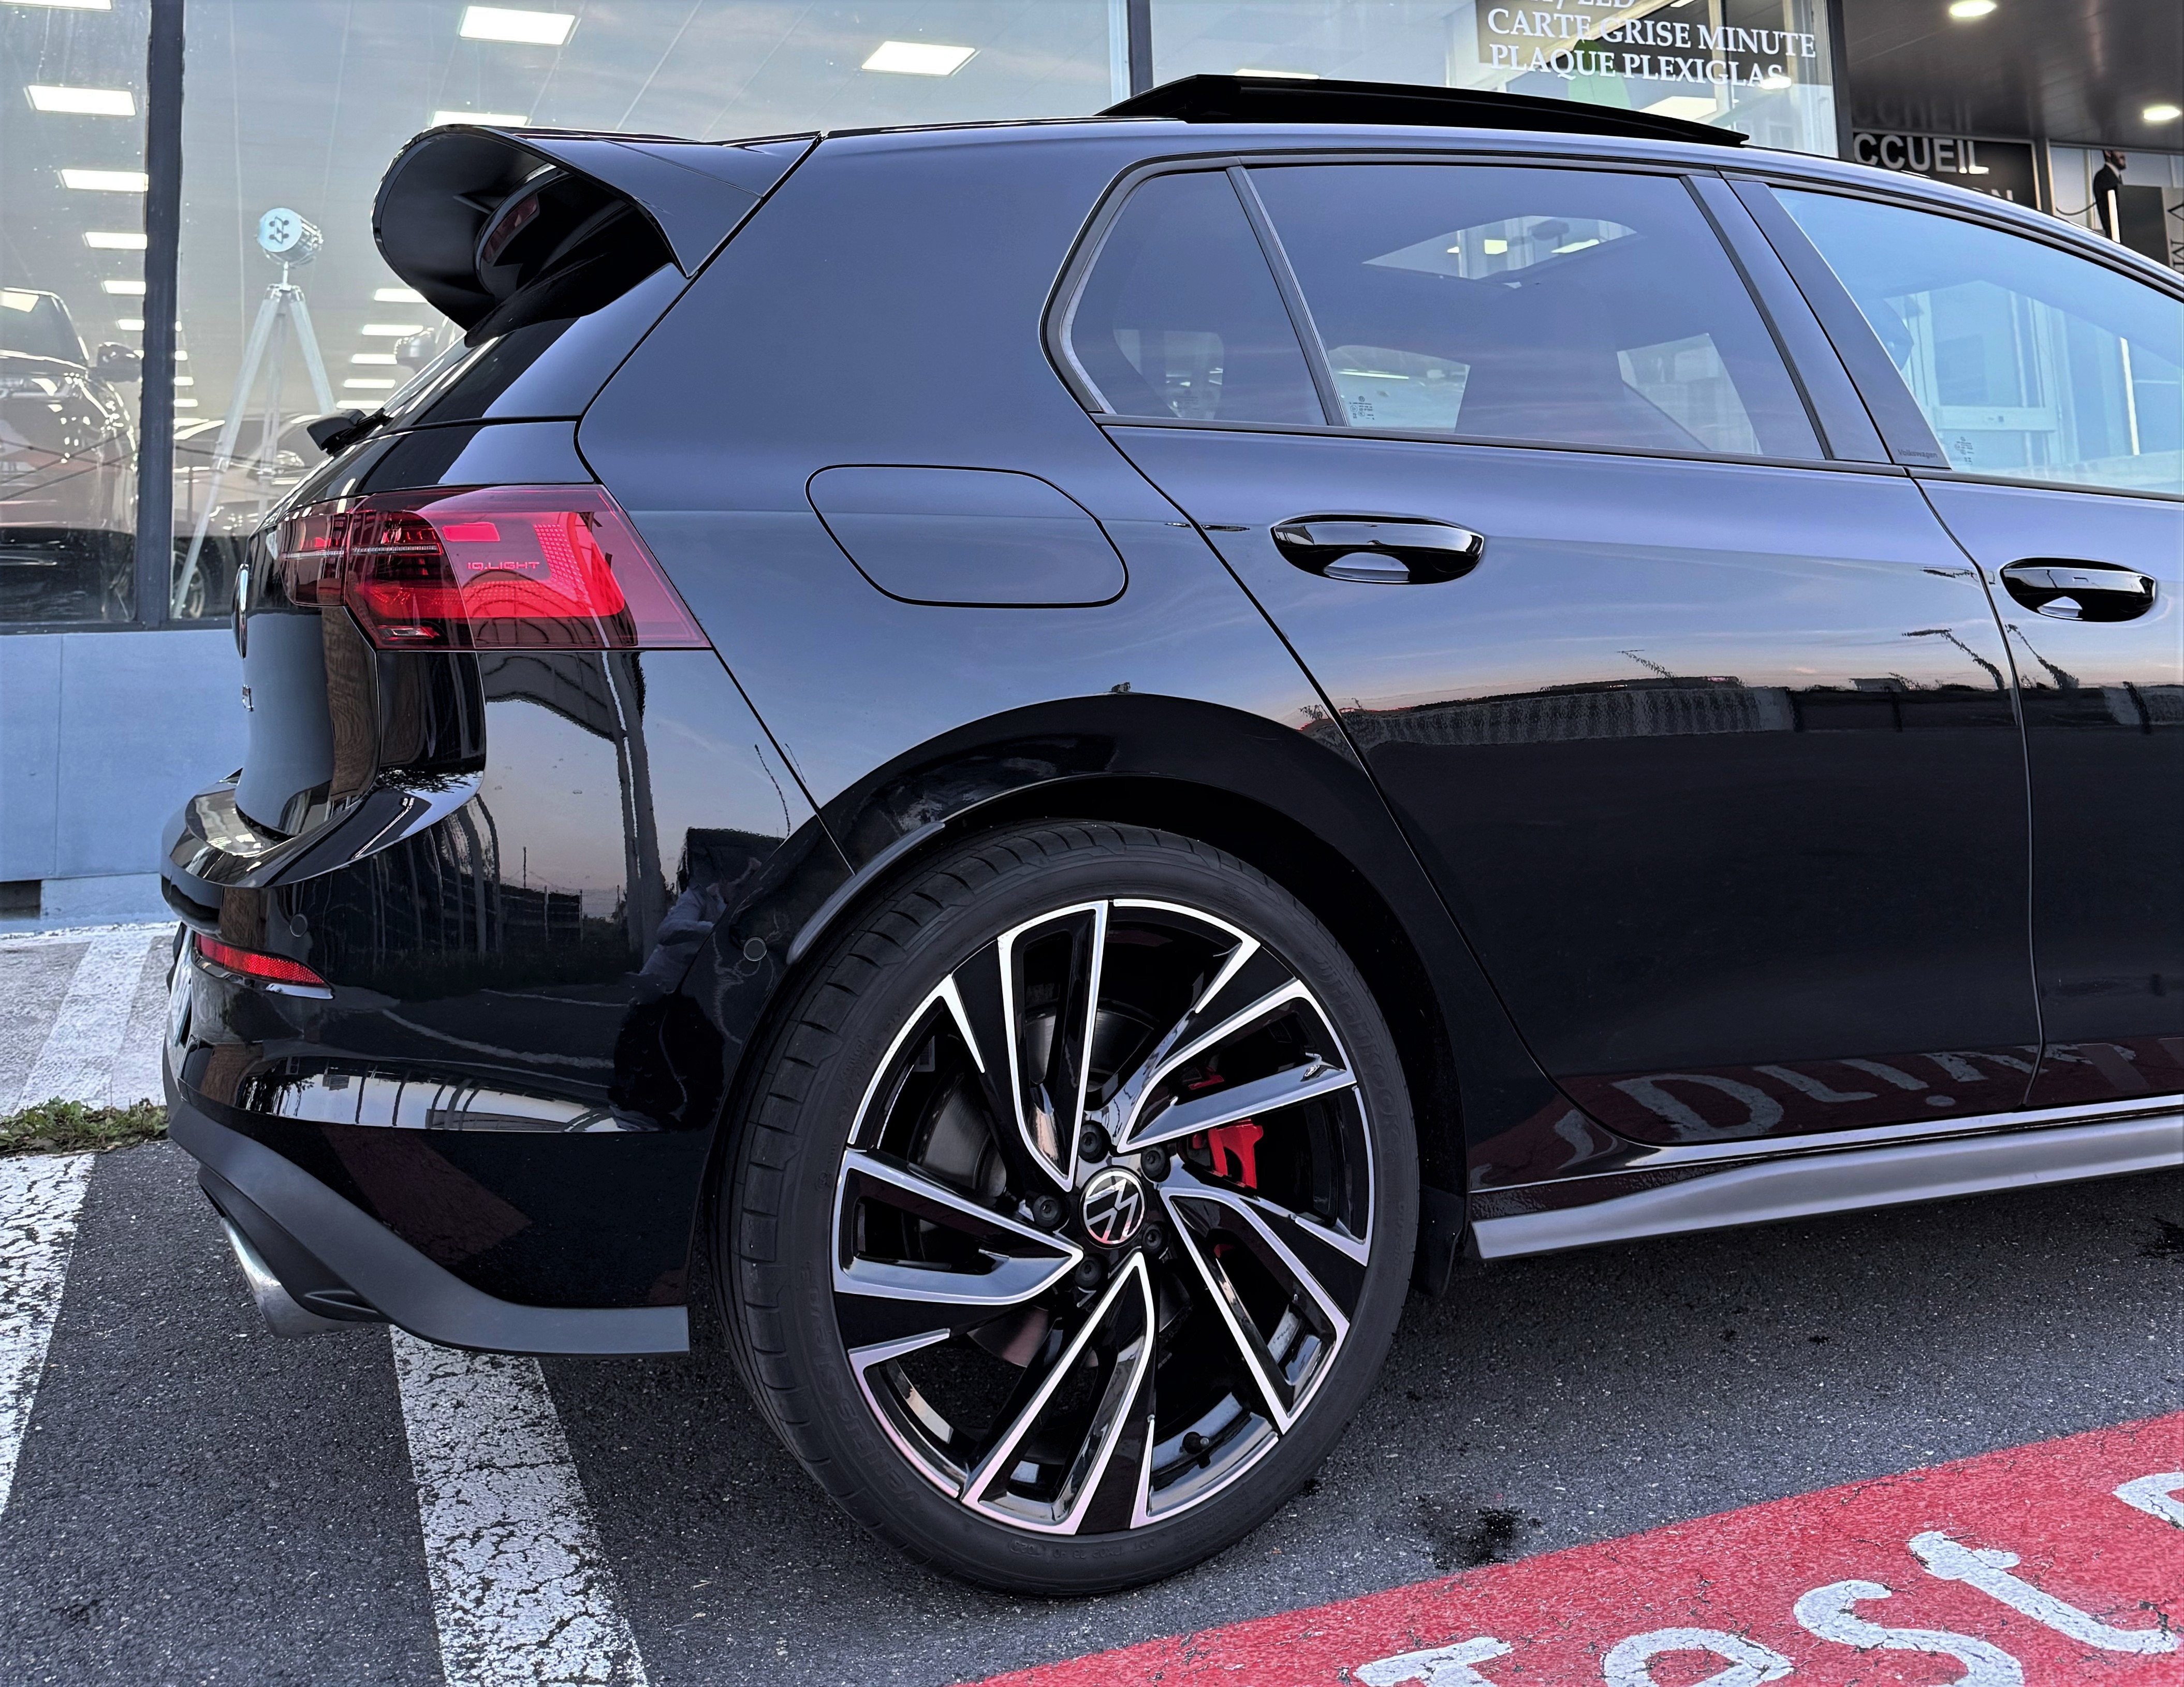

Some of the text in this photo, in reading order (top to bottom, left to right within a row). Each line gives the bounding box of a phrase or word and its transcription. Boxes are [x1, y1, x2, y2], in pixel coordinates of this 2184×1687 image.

[1488, 8, 1816, 59] CARTE GRISE MINUTE
[1489, 44, 1786, 89] PLAQUE PLEXIGLAS
[1897, 448, 1938, 459] Volkswagen
[467, 561, 540, 571] IQ.LIGHT
